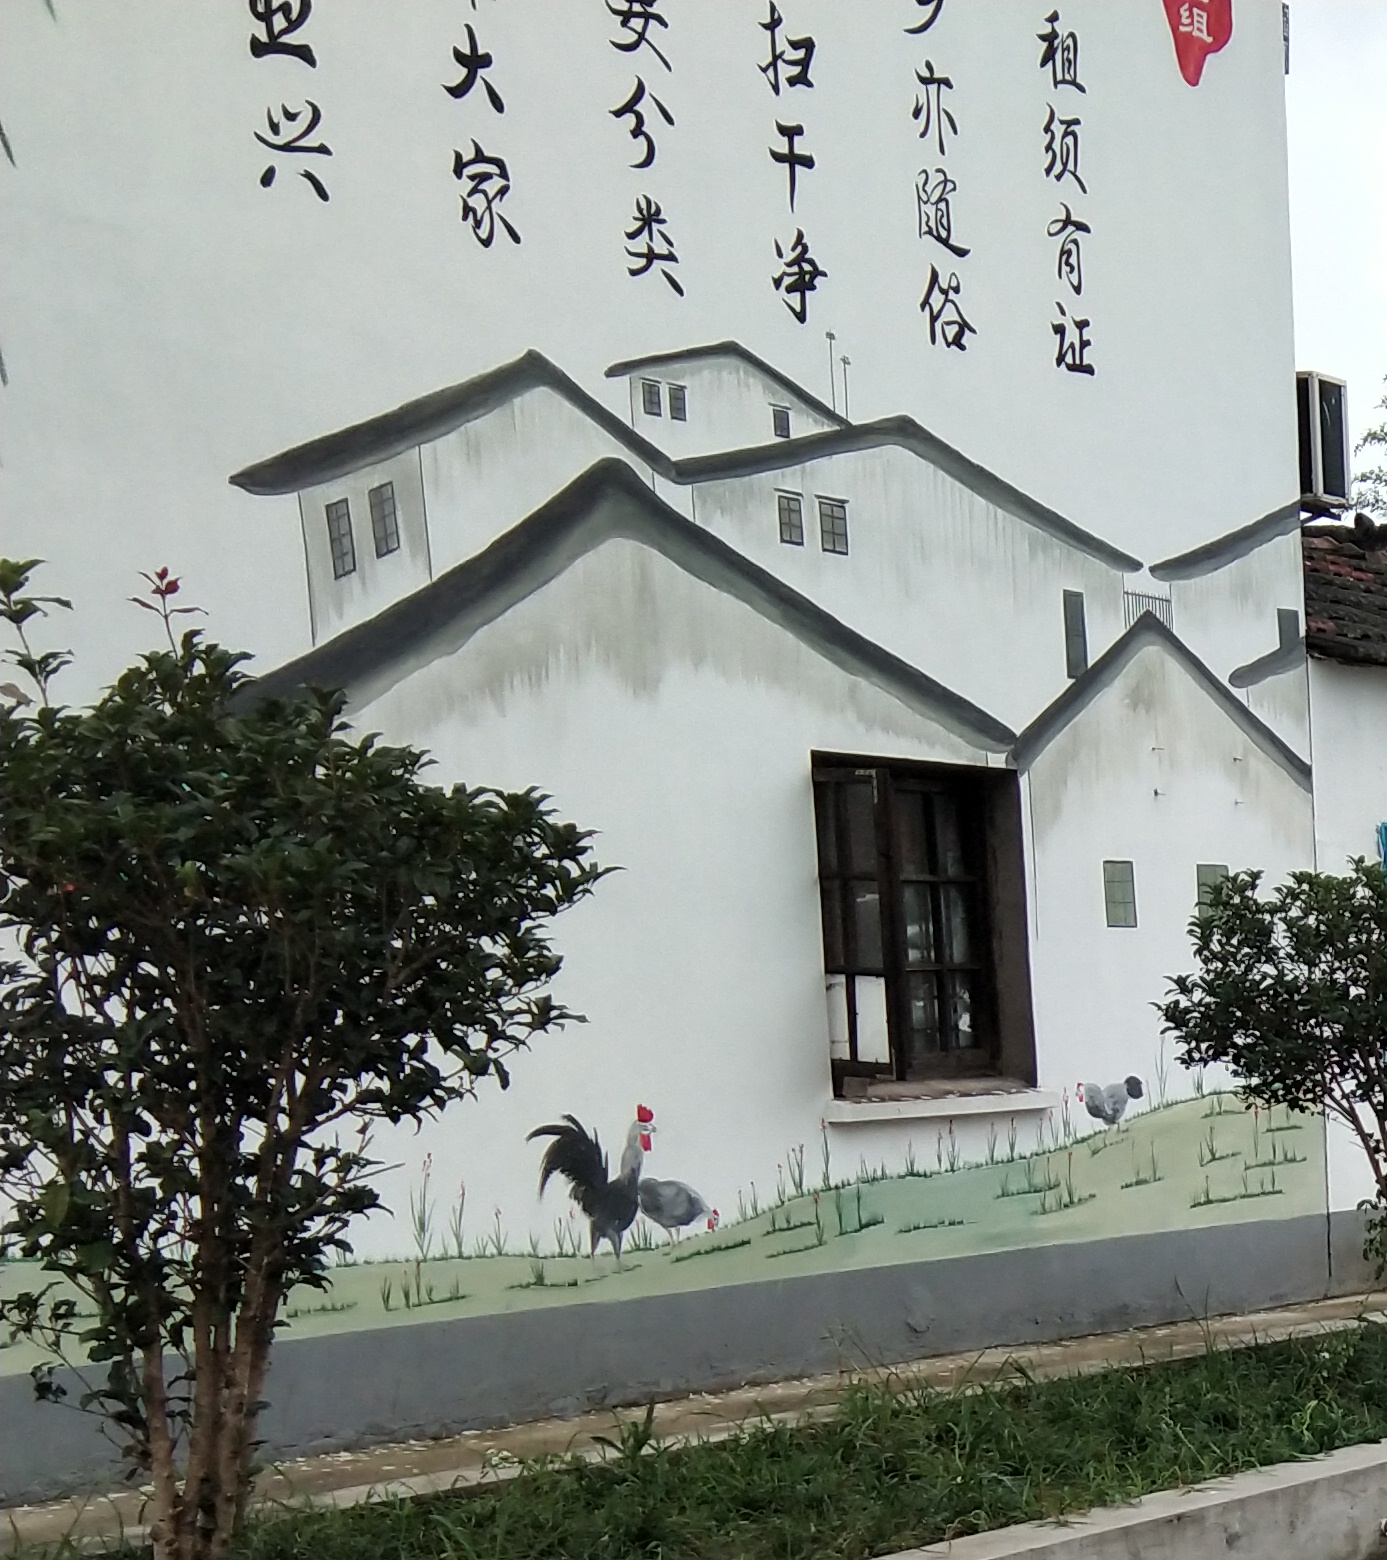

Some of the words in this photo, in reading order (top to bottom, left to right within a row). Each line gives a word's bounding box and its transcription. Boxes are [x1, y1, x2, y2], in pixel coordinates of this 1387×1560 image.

[441, 0, 522, 249] 大家
[756, 0, 828, 324] 扫干净
[1178, 3, 1214, 43] 组
[1035, 9, 1096, 376] 租须有证
